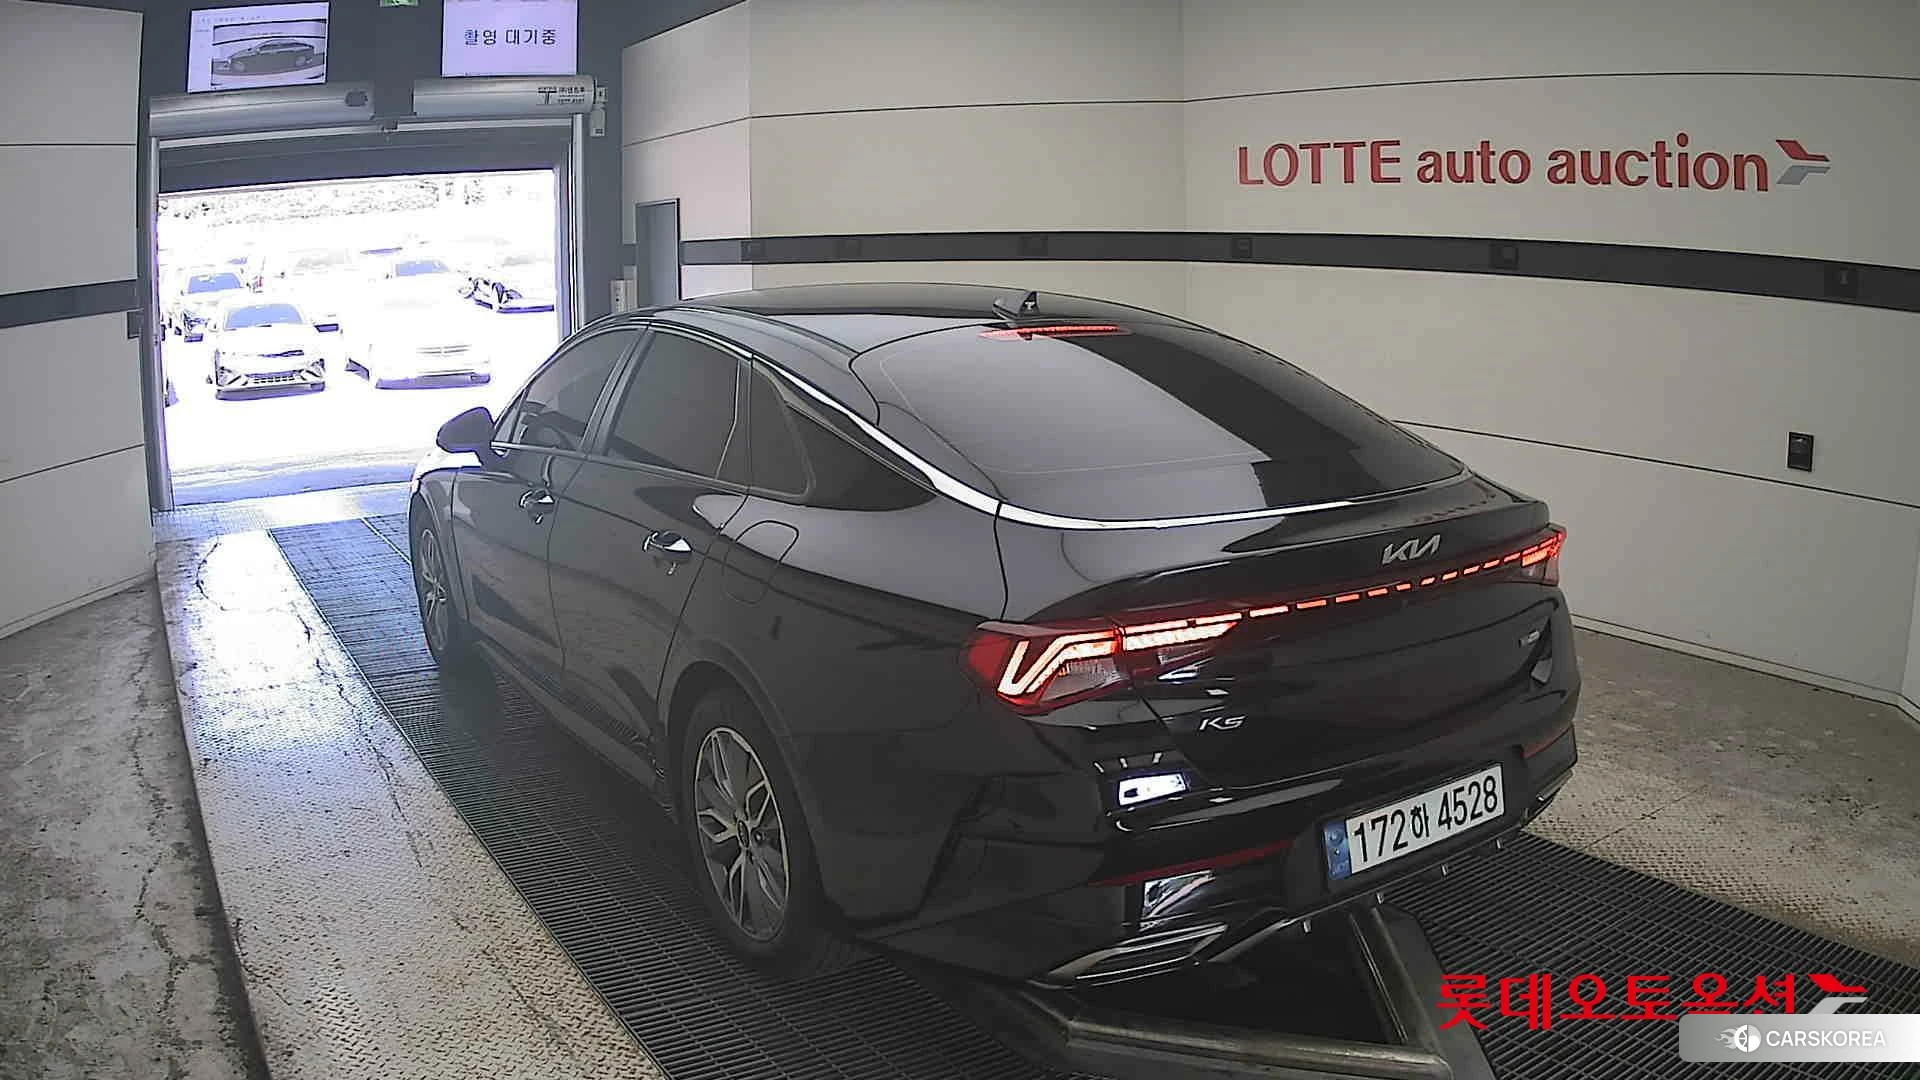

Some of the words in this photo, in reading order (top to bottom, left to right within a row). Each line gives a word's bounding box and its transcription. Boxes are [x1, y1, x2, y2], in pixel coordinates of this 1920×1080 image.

[505, 28, 556, 46] 대기중
[1238, 139, 1401, 187] LOTTE
[1416, 139, 1532, 184] auto
[1546, 132, 1769, 193] auction
[1199, 715, 1246, 730] K5
[1353, 802, 1431, 864] 172하
[1437, 774, 1499, 831] 4528
